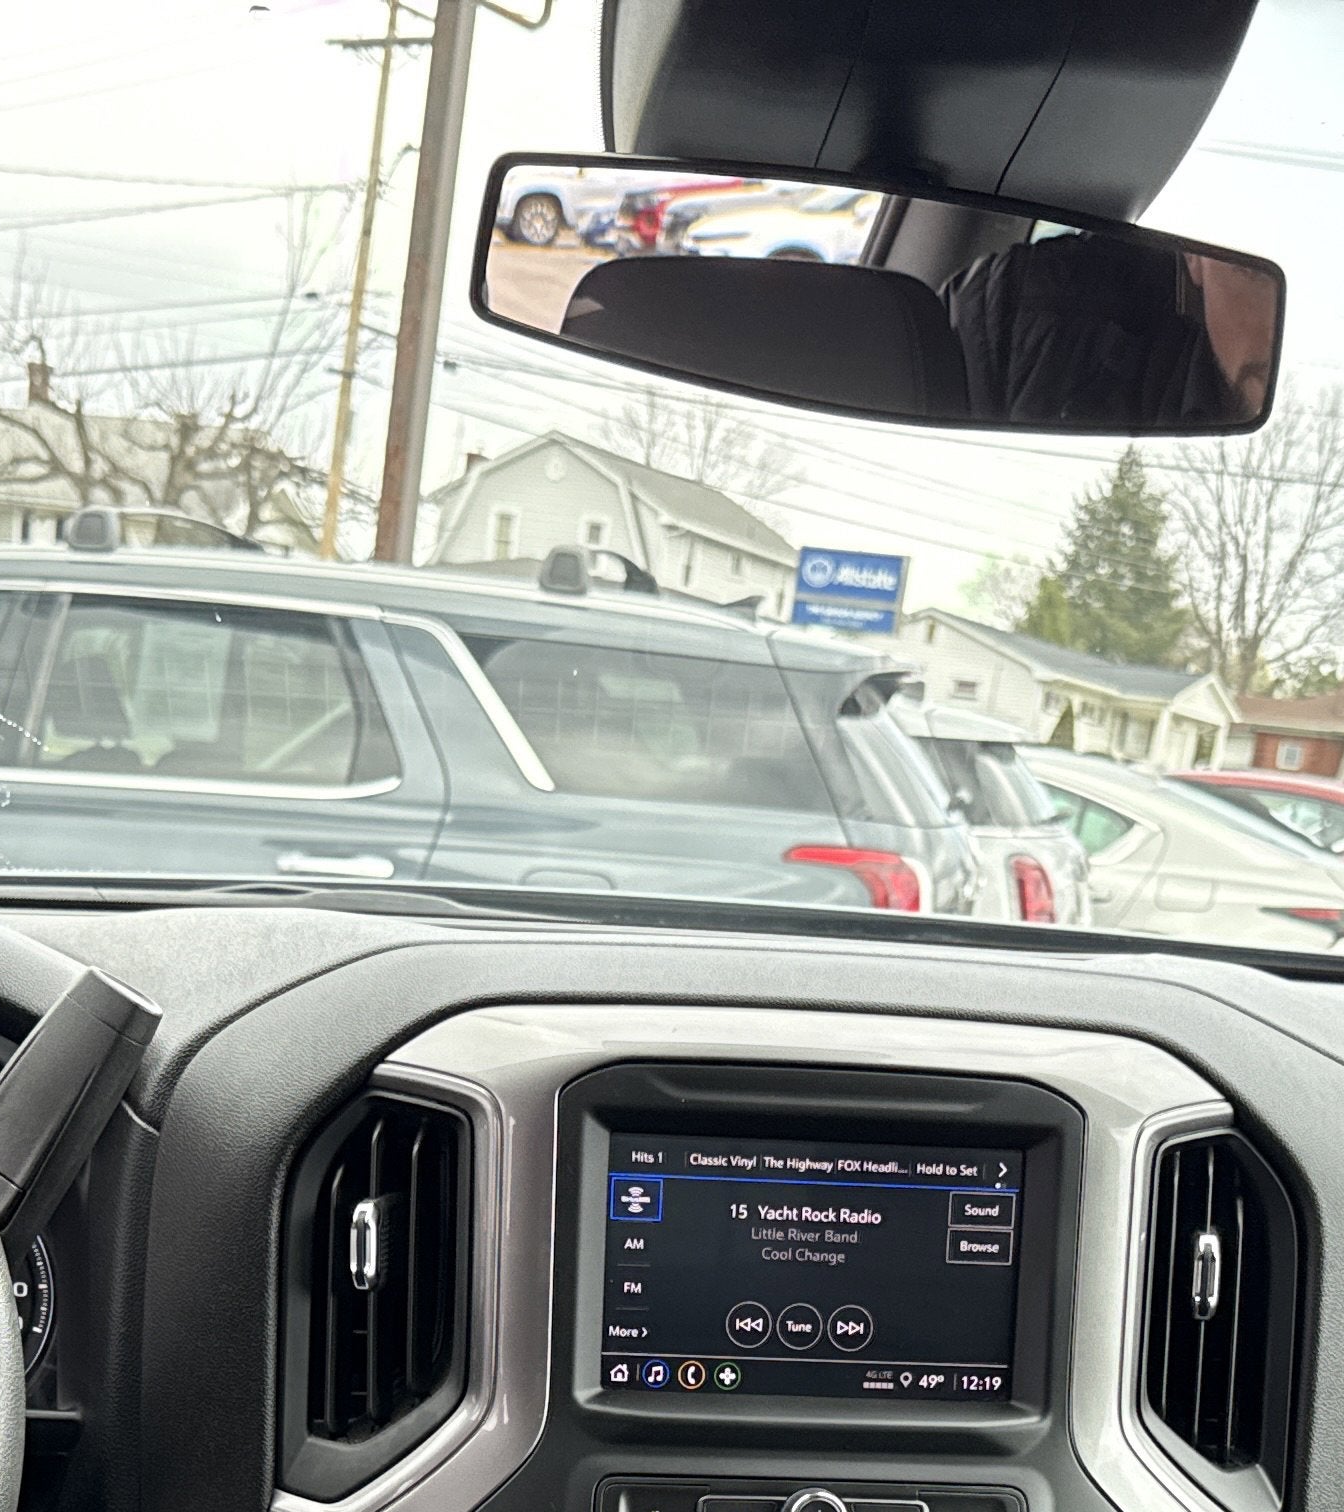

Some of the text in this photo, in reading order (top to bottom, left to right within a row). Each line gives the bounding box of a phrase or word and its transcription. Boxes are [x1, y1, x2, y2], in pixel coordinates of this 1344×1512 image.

[631, 1150, 663, 1164] Hits 1
[689, 1153, 757, 1170] Classic Vinyl
[763, 1156, 835, 1173] The Highway
[837, 1159, 862, 1172] FOX
[916, 1162, 978, 1177] Hold to Set
[730, 1203, 882, 1225] 15 Yacht Rock Radio
[964, 1203, 1000, 1217] Sound
[751, 1226, 858, 1244] Little River Band
[623, 1238, 645, 1250] AM
[959, 1240, 1000, 1254] Browse
[761, 1247, 846, 1266] Cool Change
[623, 1281, 642, 1295] FM
[608, 1325, 639, 1338] More
[785, 1320, 813, 1333] Tune
[961, 1375, 1002, 1391] 12:19
